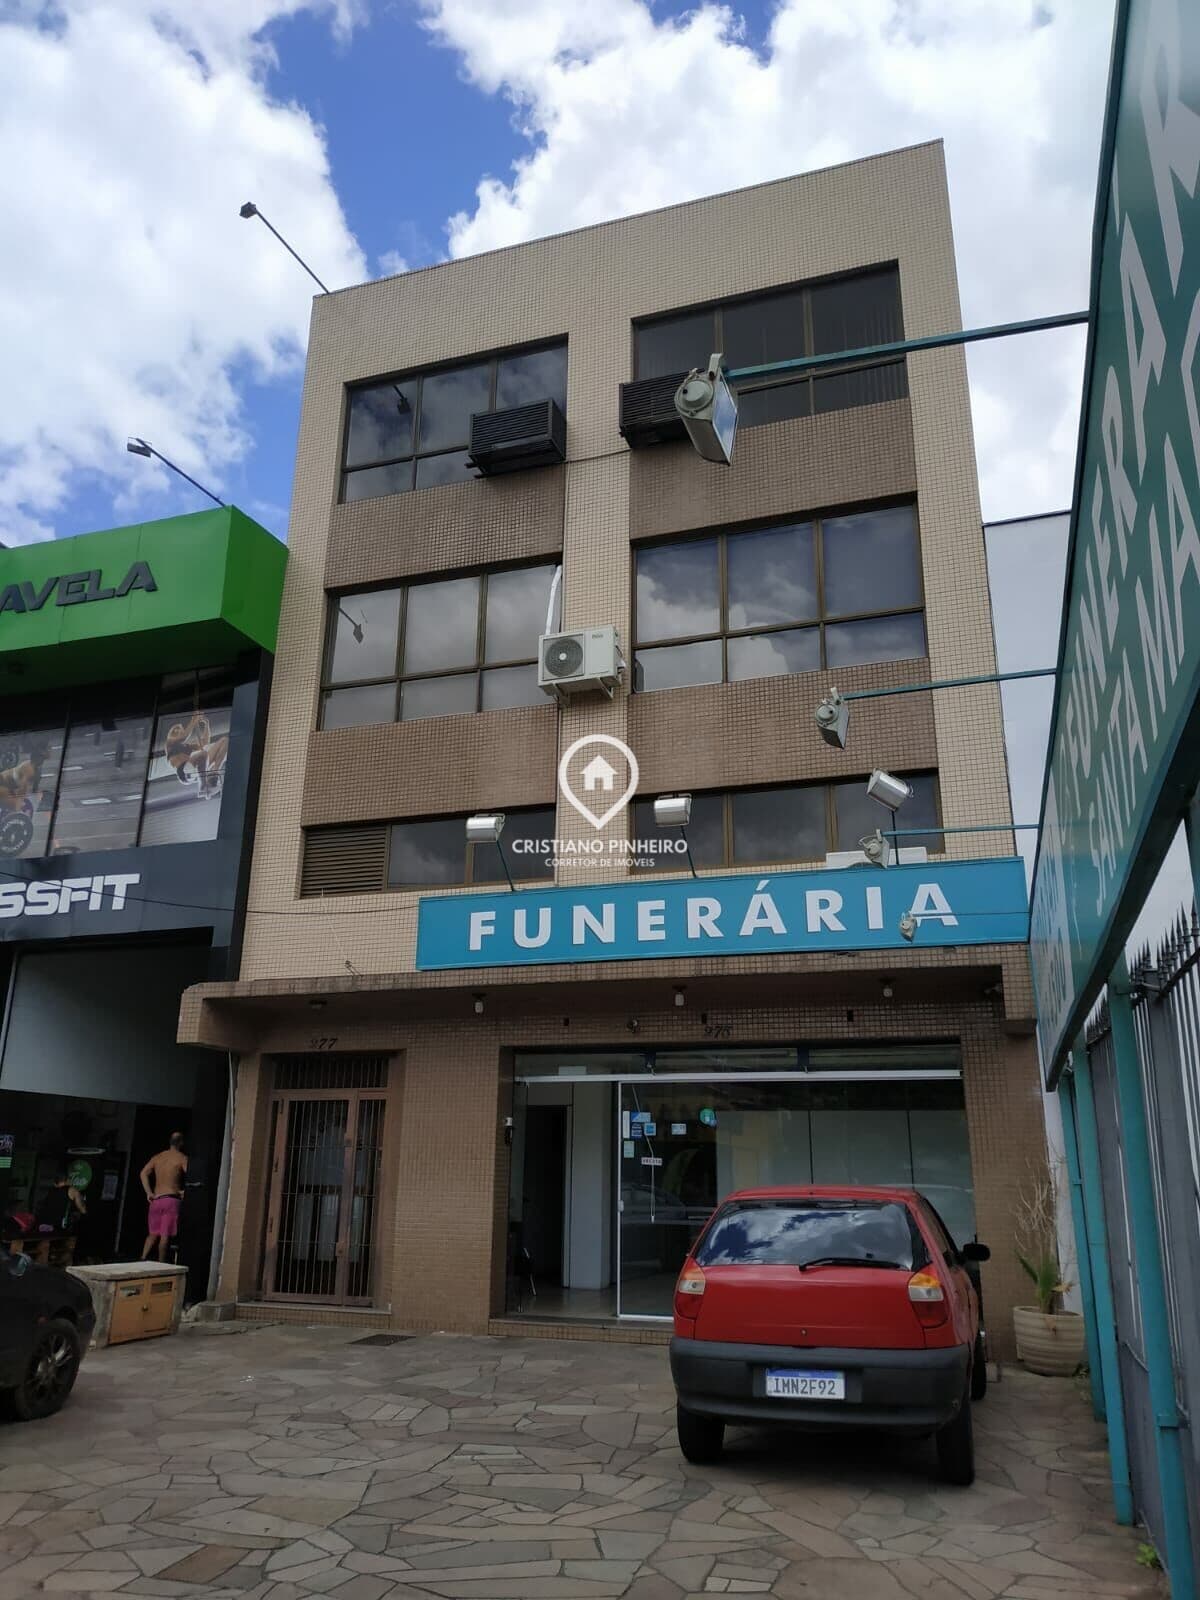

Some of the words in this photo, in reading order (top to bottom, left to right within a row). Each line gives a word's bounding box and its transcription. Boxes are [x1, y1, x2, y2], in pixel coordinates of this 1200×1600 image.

[1089, 648, 1148, 916] SANTA
[468, 880, 960, 952] FUNERÁRIA
[773, 1377, 836, 1395] IMN2F92
